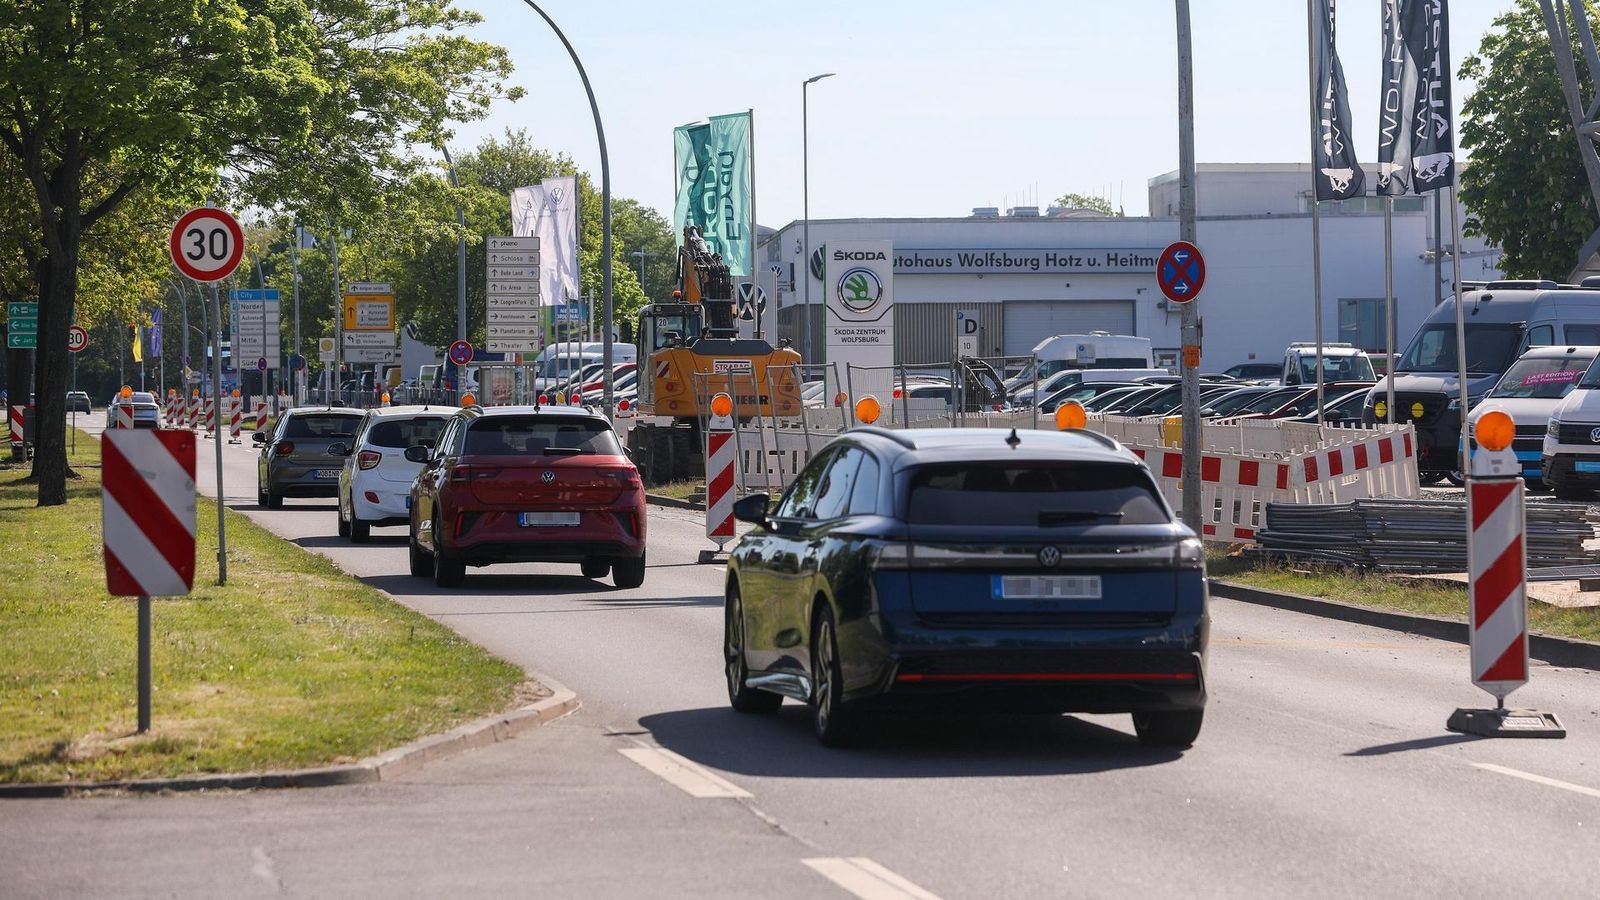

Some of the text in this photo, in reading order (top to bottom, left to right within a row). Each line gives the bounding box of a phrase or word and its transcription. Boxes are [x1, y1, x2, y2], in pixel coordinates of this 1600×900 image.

[187, 228, 228, 260] 30
[833, 250, 886, 261] ŠKODA
[957, 253, 1038, 270] Wolfsburg
[1045, 252, 1081, 267] Hotz
[1087, 256, 1100, 267] u.
[658, 318, 667, 327] 20
[964, 319, 978, 334] D
[834, 328, 855, 336] ŠKODA
[841, 336, 880, 344] WOLFSBURG
